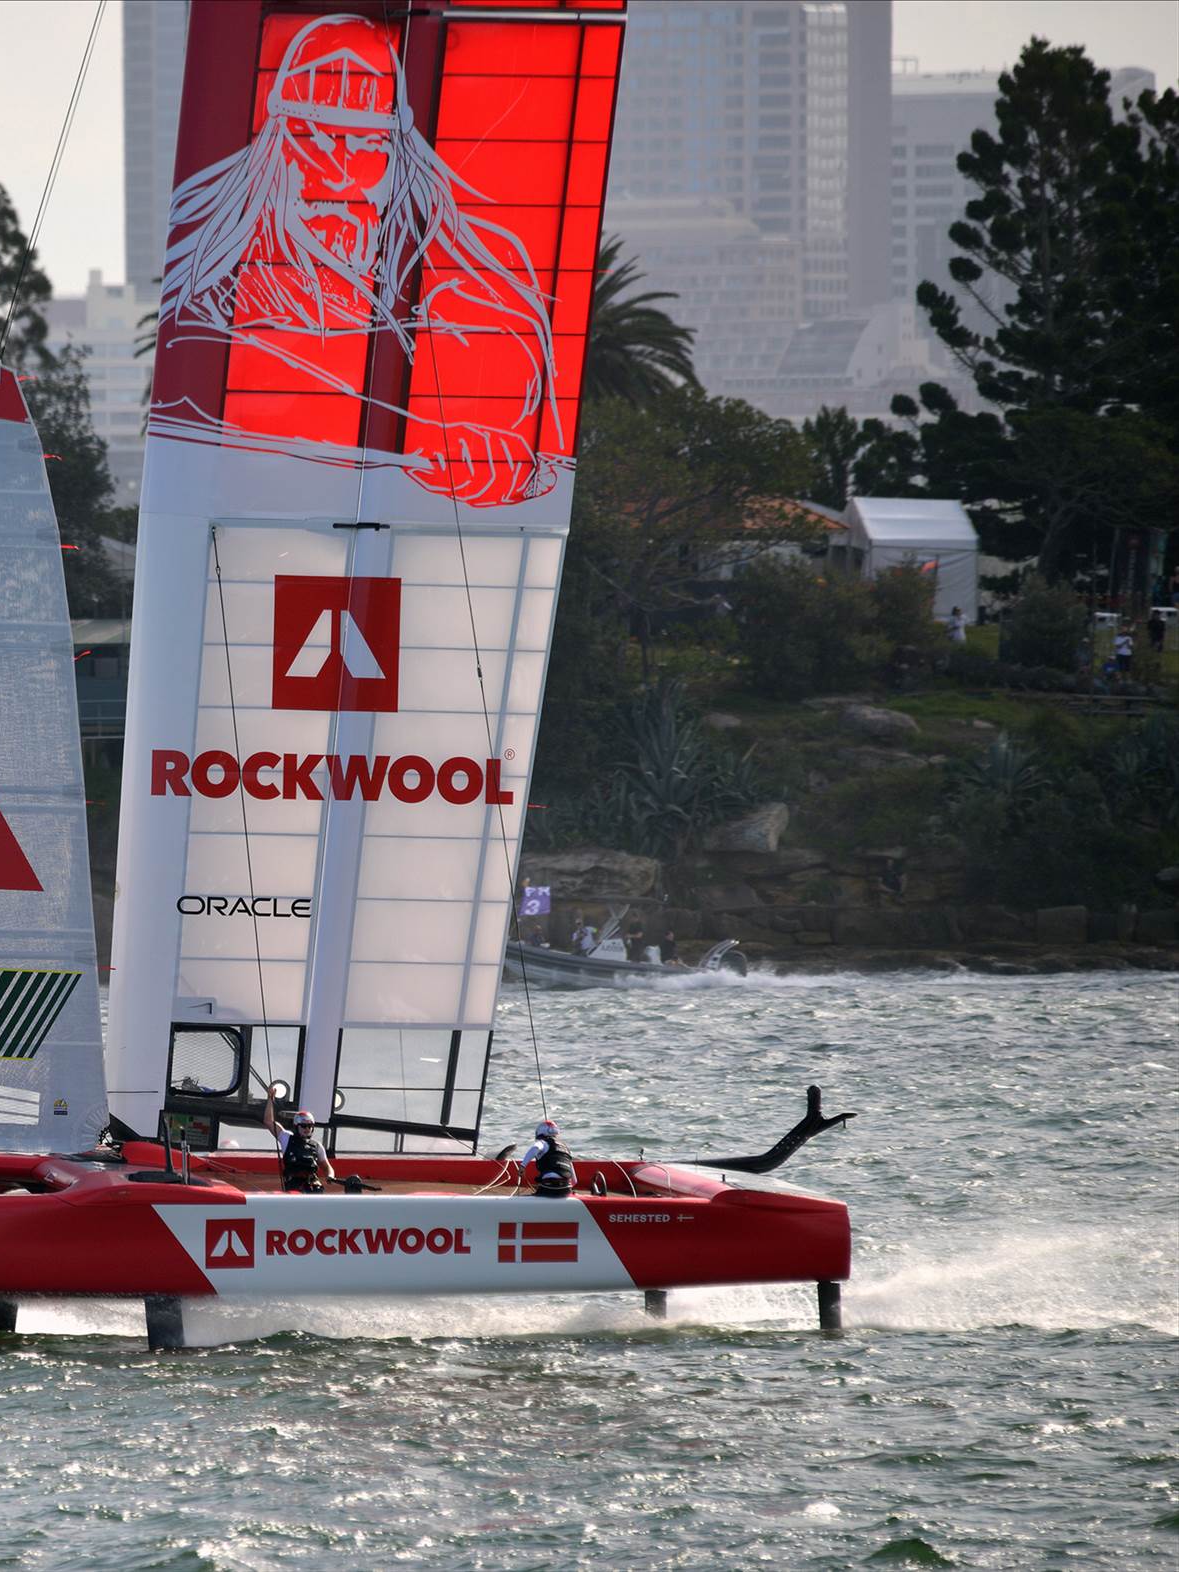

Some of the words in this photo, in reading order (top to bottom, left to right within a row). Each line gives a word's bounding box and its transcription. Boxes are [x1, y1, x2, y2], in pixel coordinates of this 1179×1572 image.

[176, 895, 312, 918] ORACLE
[524, 898, 540, 915] 3
[608, 1213, 670, 1223] SEHESTED
